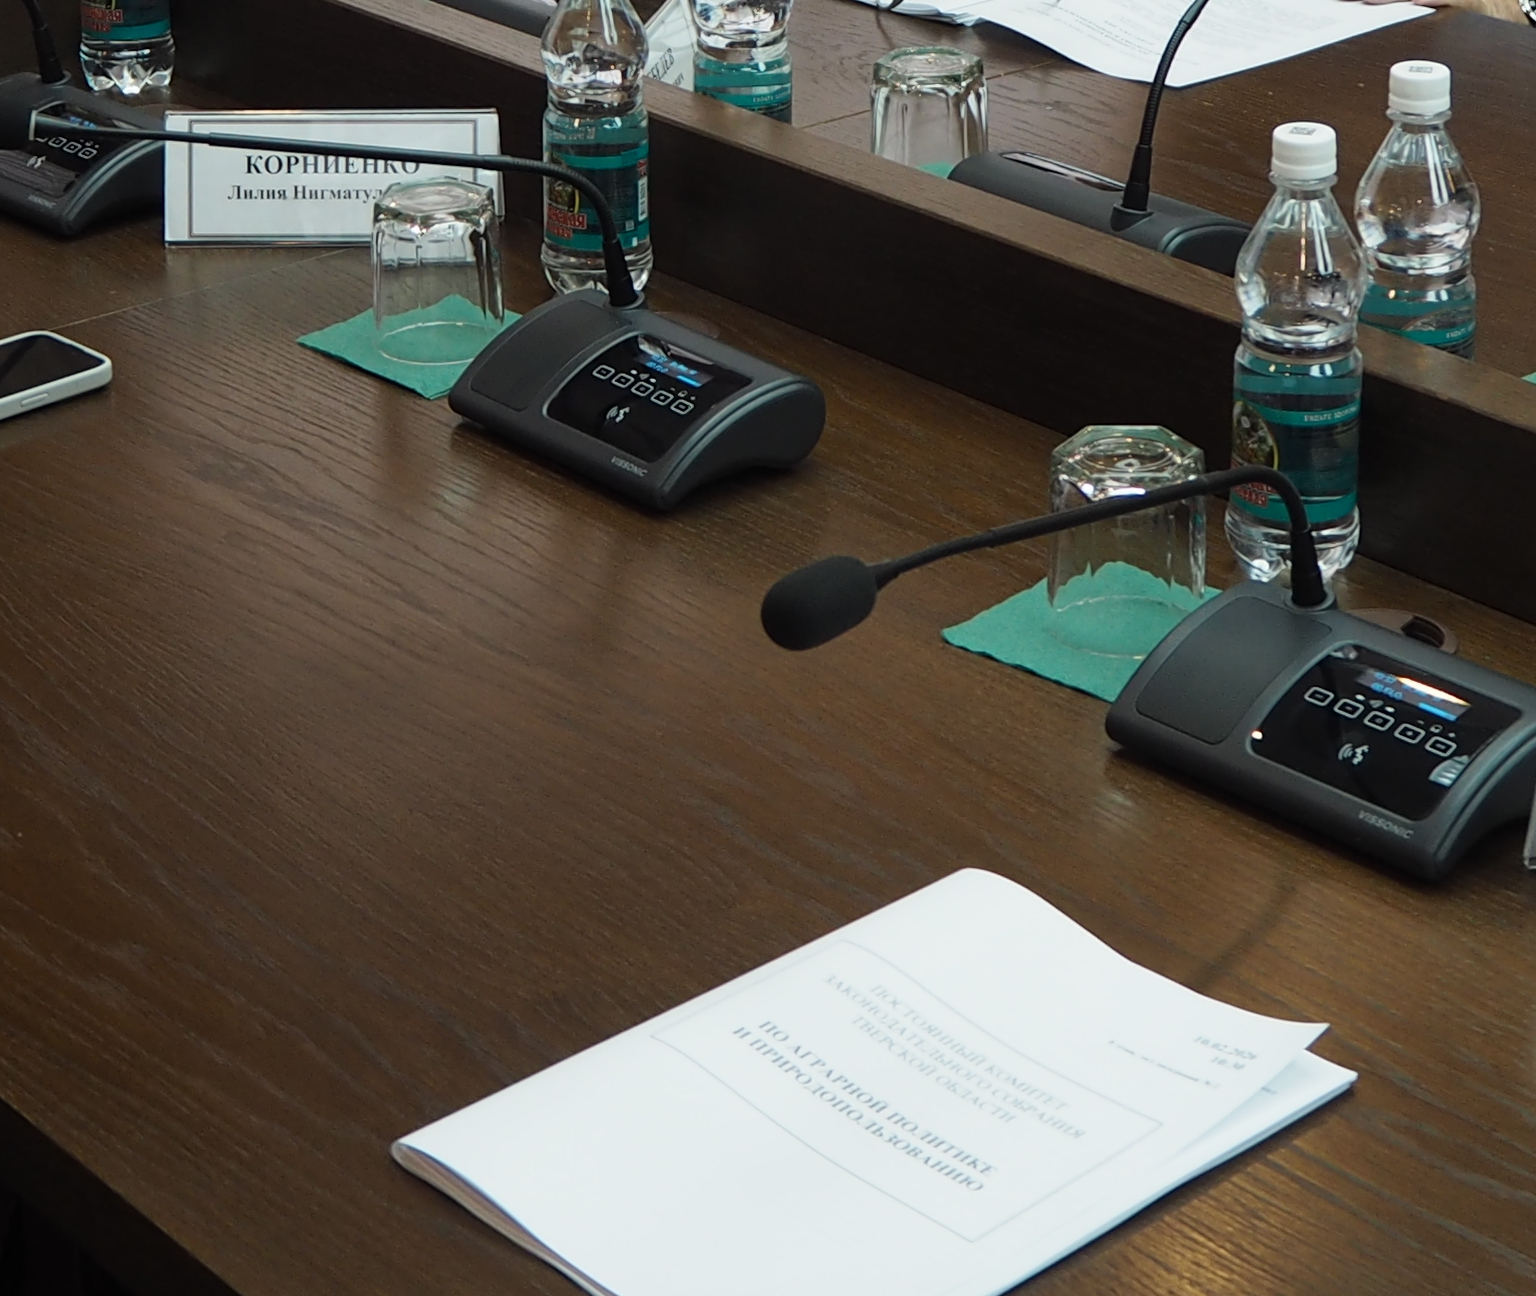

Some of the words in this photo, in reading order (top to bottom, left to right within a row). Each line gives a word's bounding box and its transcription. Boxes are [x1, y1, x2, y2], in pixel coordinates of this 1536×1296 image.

[227, 185, 287, 200] Лилия
[292, 185, 384, 204] Нигматул
[1358, 810, 1414, 839] VISSONIC
[732, 1026, 754, 1039] И
[749, 1037, 985, 1192] ПРИРОДОПОЛЬЗОВАНИЮ
[758, 1020, 790, 1044] ПО
[788, 1039, 890, 1114] АГРАРНОЙ
[887, 1110, 997, 1177] ПОЛИТИКЕ
[823, 972, 994, 1090] ЗАКОНОДАТЕЛЬНОГО
[992, 1085, 1087, 1140] СОБРАНИЯ
[851, 1016, 940, 1078] ТВЕРСКОЙ
[935, 1073, 1017, 1124] ОБЛАСТИ
[870, 984, 987, 1066] ПОСТОЯННЫЙ
[983, 1063, 1069, 1111] КОМИТЕТ
